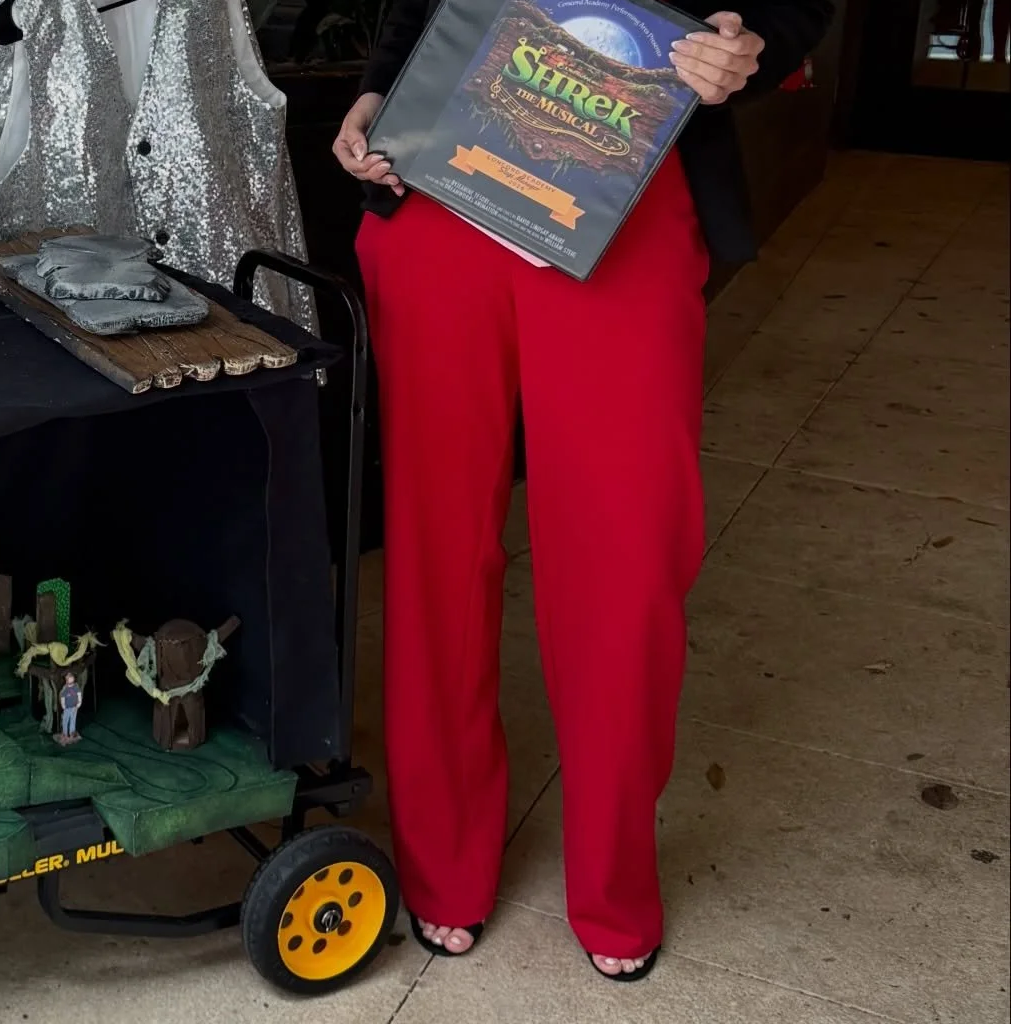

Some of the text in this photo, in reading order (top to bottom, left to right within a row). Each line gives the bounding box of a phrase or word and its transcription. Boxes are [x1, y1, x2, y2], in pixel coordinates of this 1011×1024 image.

[584, 0, 610, 10] Academy
[610, 3, 640, 26] Performing
[516, 87, 599, 138] THE MUSICAL
[487, 155, 556, 193] CONCORD ACADEMY
[76, 840, 125, 864] MUL
